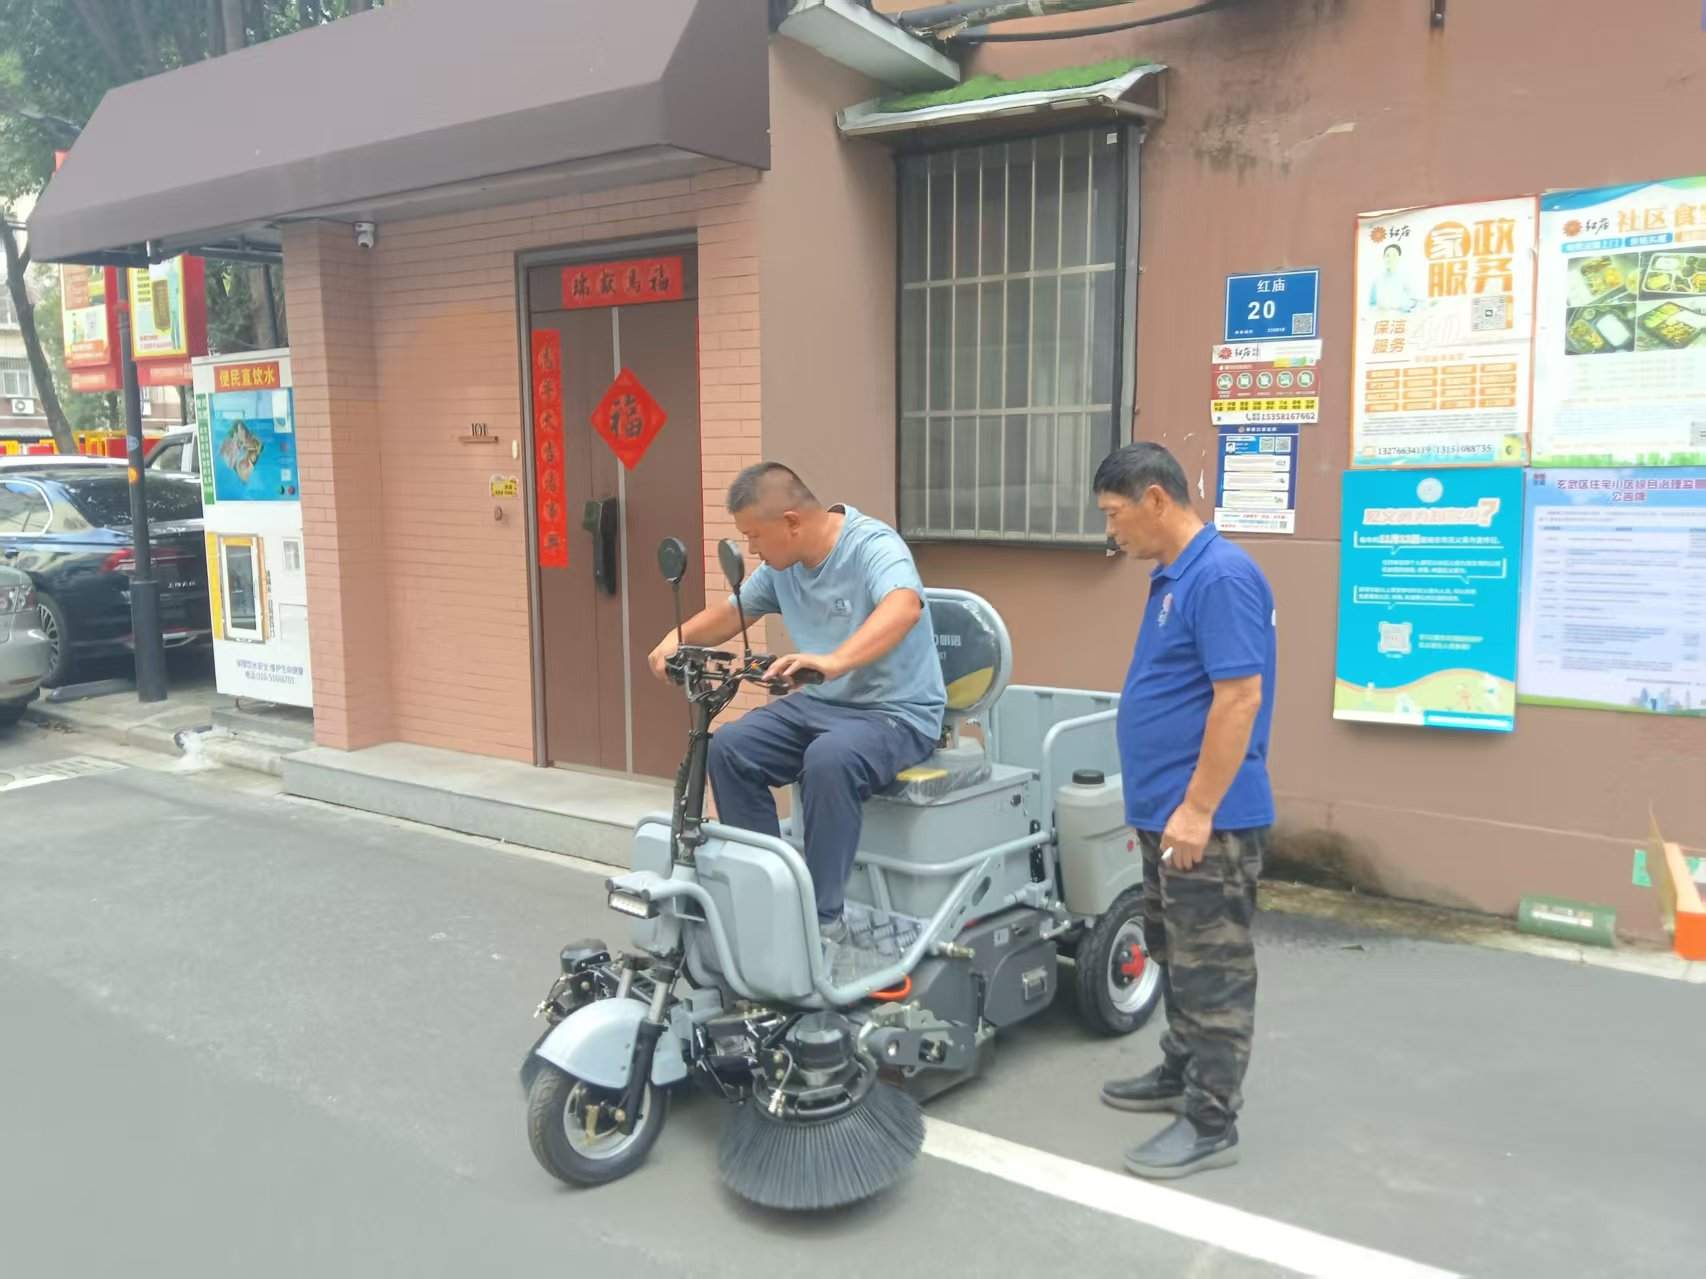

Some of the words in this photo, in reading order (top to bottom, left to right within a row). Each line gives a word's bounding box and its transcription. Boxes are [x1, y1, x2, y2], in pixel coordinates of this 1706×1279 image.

[1424, 219, 1515, 260] 家政
[1257, 278, 1285, 293] 红庙
[1428, 257, 1512, 297] 服务
[1248, 300, 1276, 320] 20
[1374, 319, 1407, 336] 保洁
[1372, 338, 1406, 354] 服务
[219, 366, 276, 388] 便民直饮水
[609, 391, 645, 439] 福
[1261, 411, 1316, 422] 15358167662
[471, 422, 488, 438] 101
[1557, 479, 1706, 490] 玄武区住宅小区综合治理监
